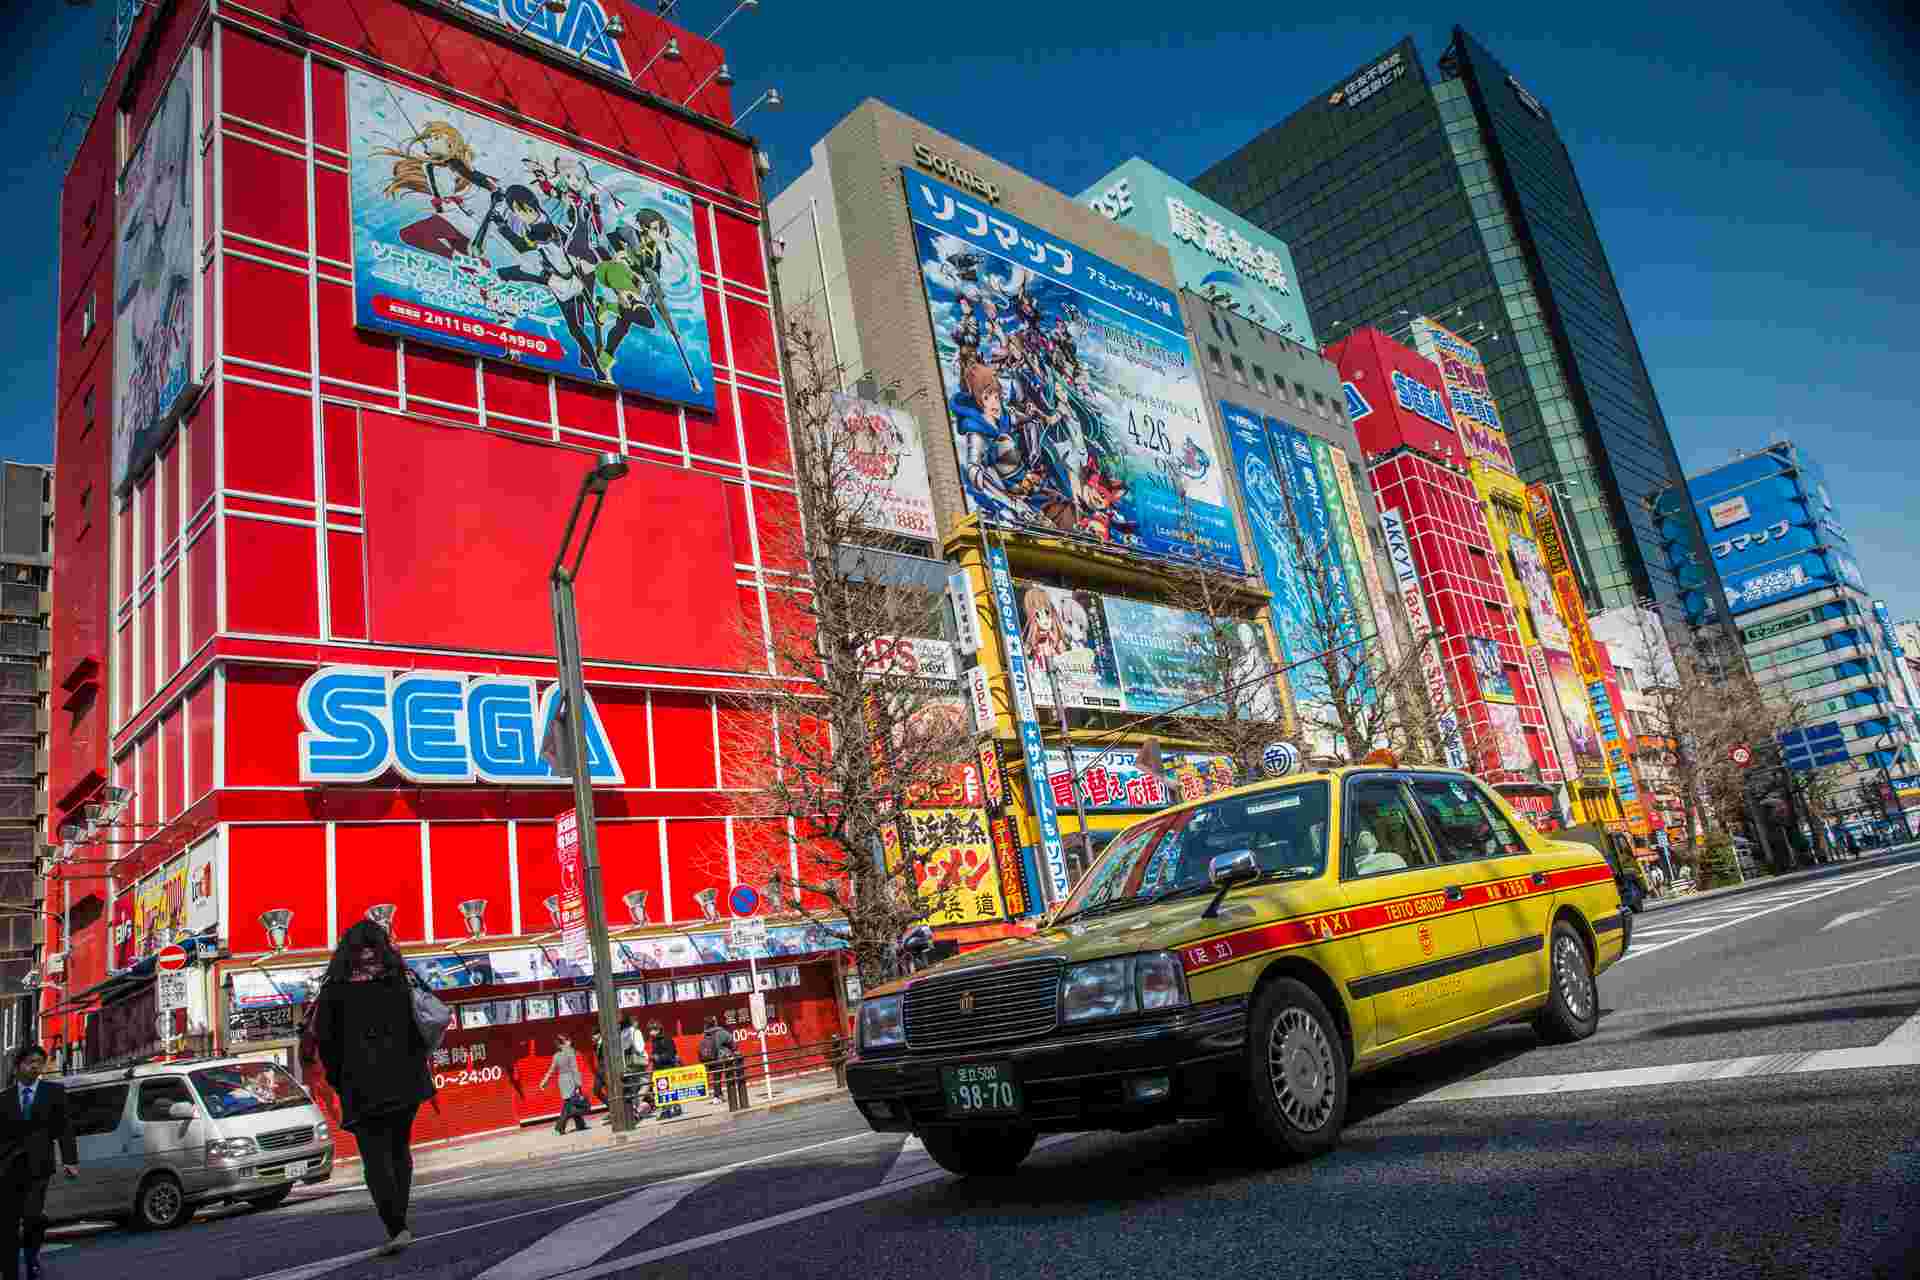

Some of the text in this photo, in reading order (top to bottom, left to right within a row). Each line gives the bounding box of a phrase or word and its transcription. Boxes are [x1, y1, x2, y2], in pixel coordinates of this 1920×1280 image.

[913, 142, 1000, 202] Sofmap
[919, 184, 1074, 276] ソフマップ
[1392, 370, 1455, 431] SEGA
[1127, 407, 1171, 455] 4.26
[1382, 515, 1412, 568] AKKY
[298, 665, 626, 784] SEGA
[1305, 912, 1352, 940] TAXI
[1384, 895, 1447, 921] TEITO GROUP
[959, 1081, 1015, 1110] 98-70
